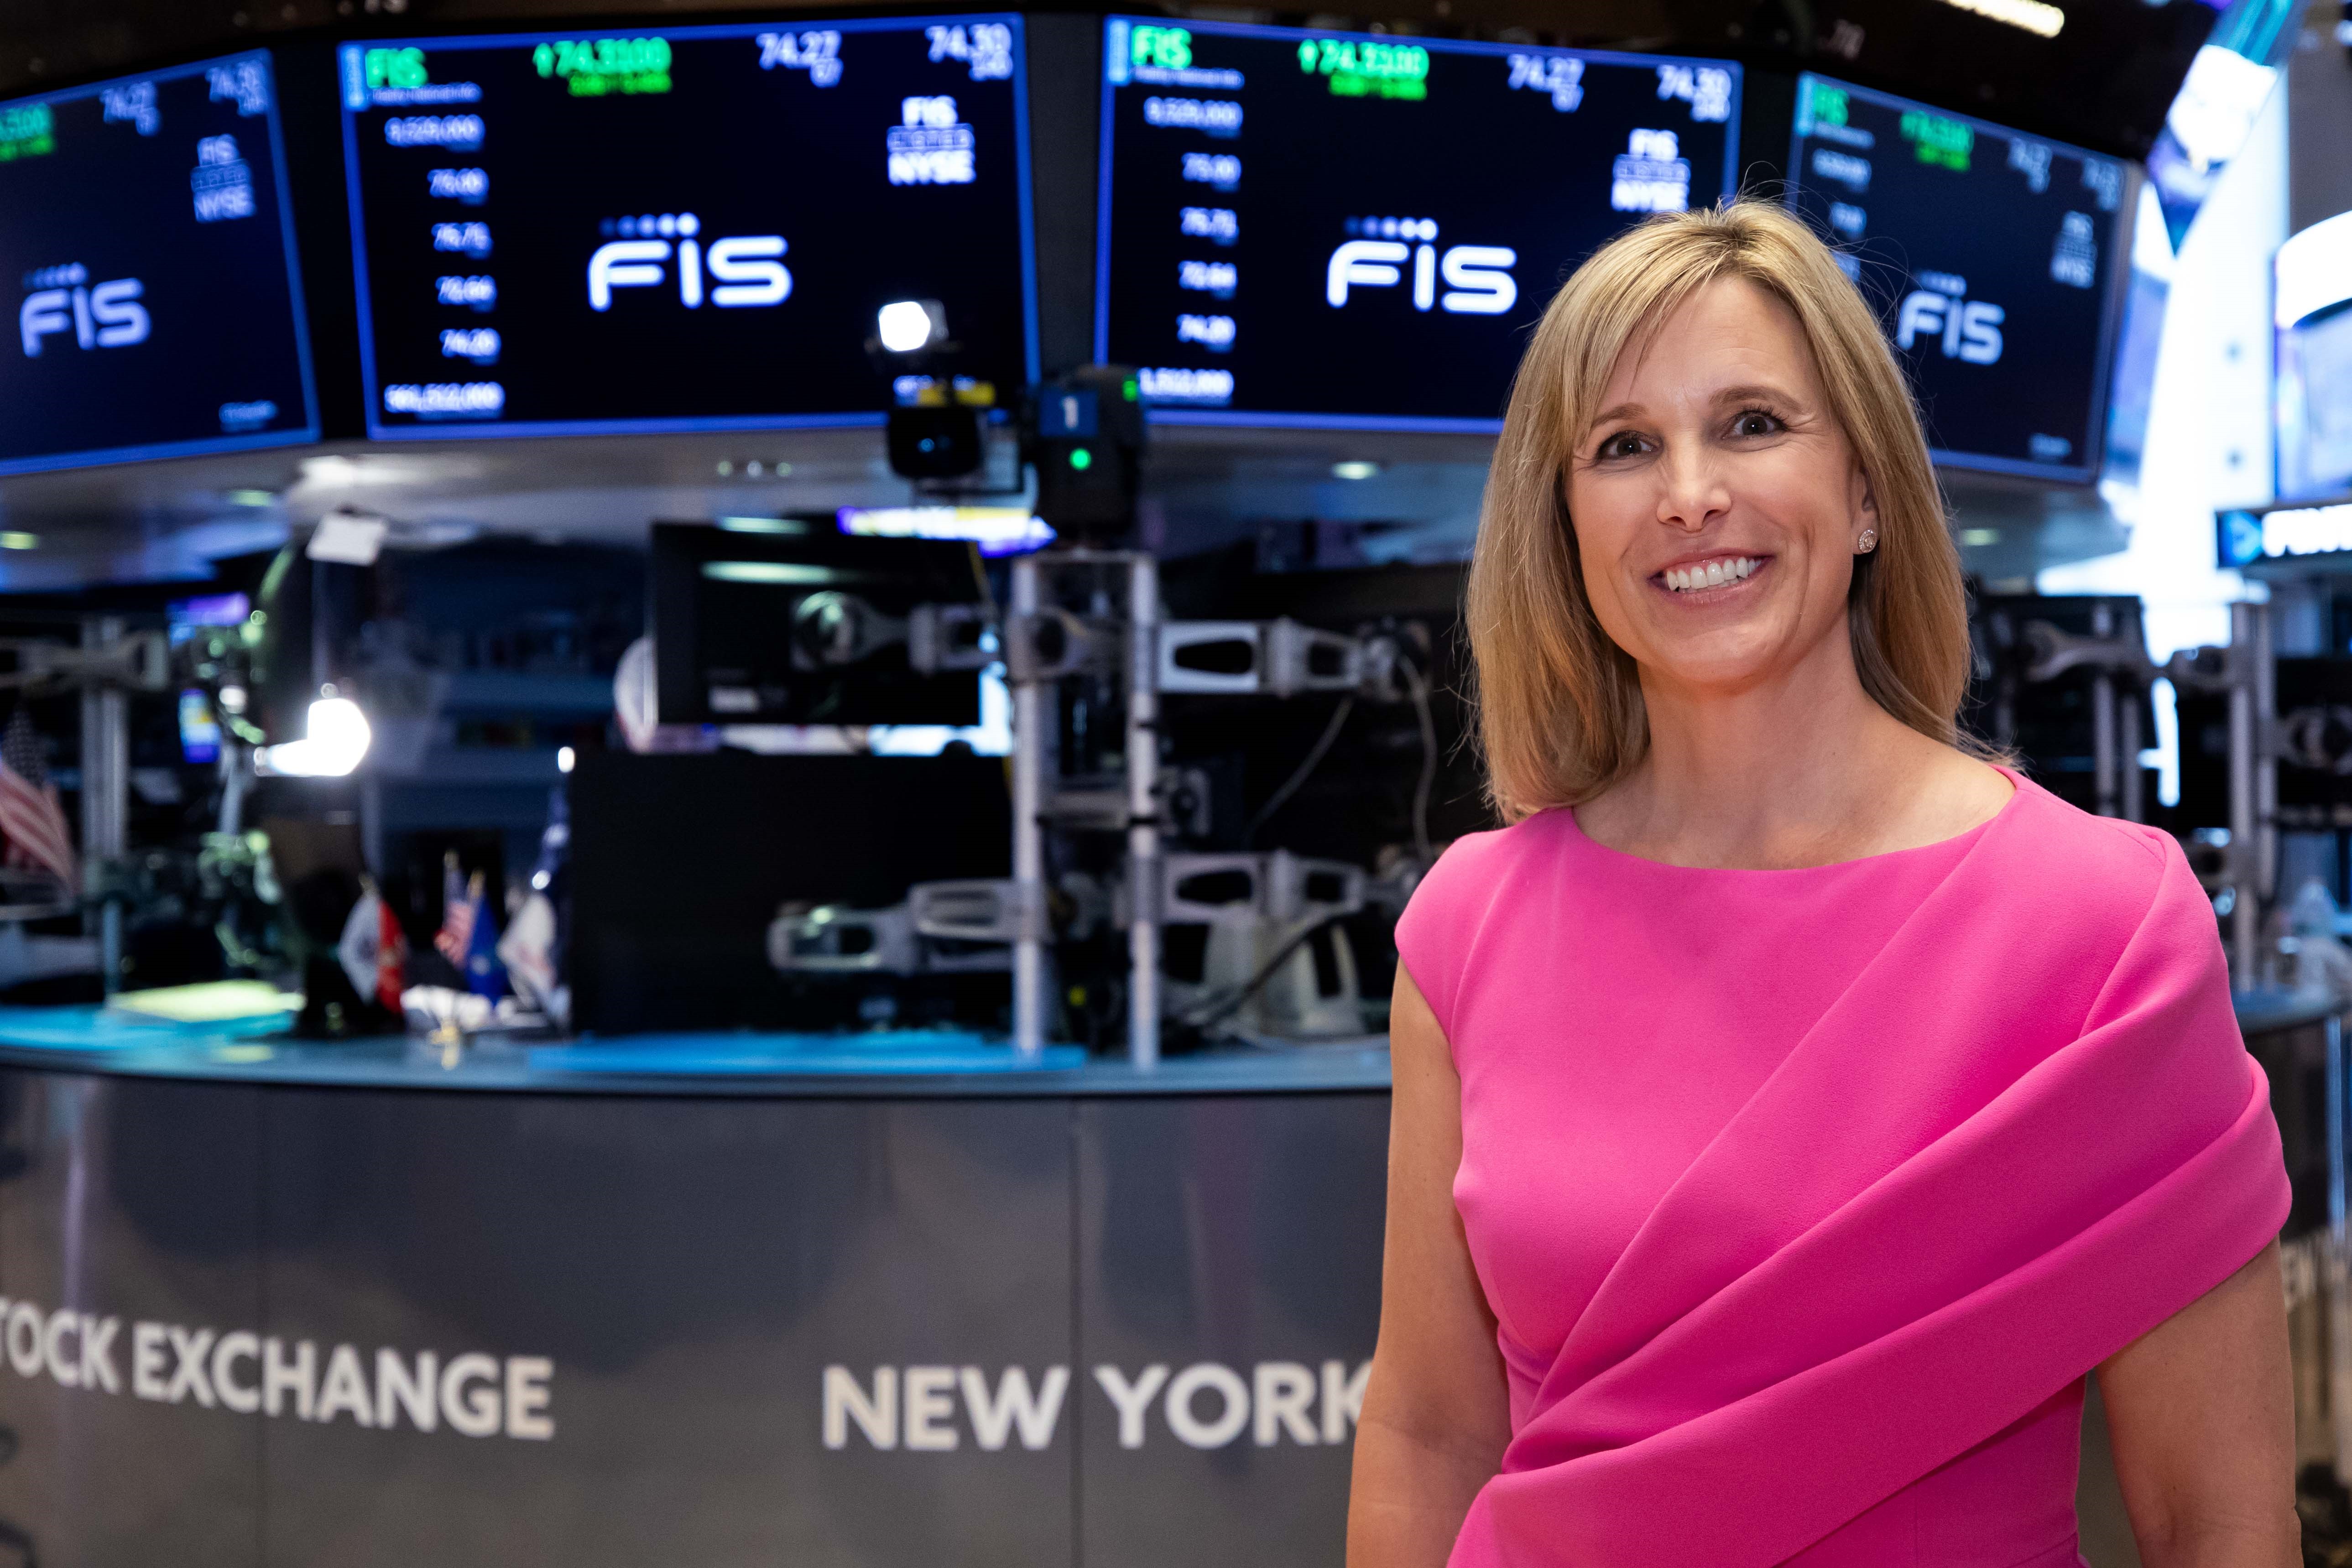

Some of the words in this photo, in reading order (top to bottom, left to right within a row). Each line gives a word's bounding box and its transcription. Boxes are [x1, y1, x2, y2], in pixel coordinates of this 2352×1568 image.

[756, 30, 841, 69] 74.27
[1132, 26, 1192, 68] FIS
[366, 47, 428, 88] FIS
[1507, 53, 1585, 91] 74.27
[902, 95, 957, 128] FIS
[1629, 128, 1678, 161] FIS
[888, 150, 976, 185] NYSE
[193, 185, 256, 223] NYSE
[0, 1298, 121, 1395] OCK
[132, 1322, 554, 1441] EXCHANGE
[824, 1365, 1071, 1451] NEW
[1094, 1361, 1372, 1448] YORK
